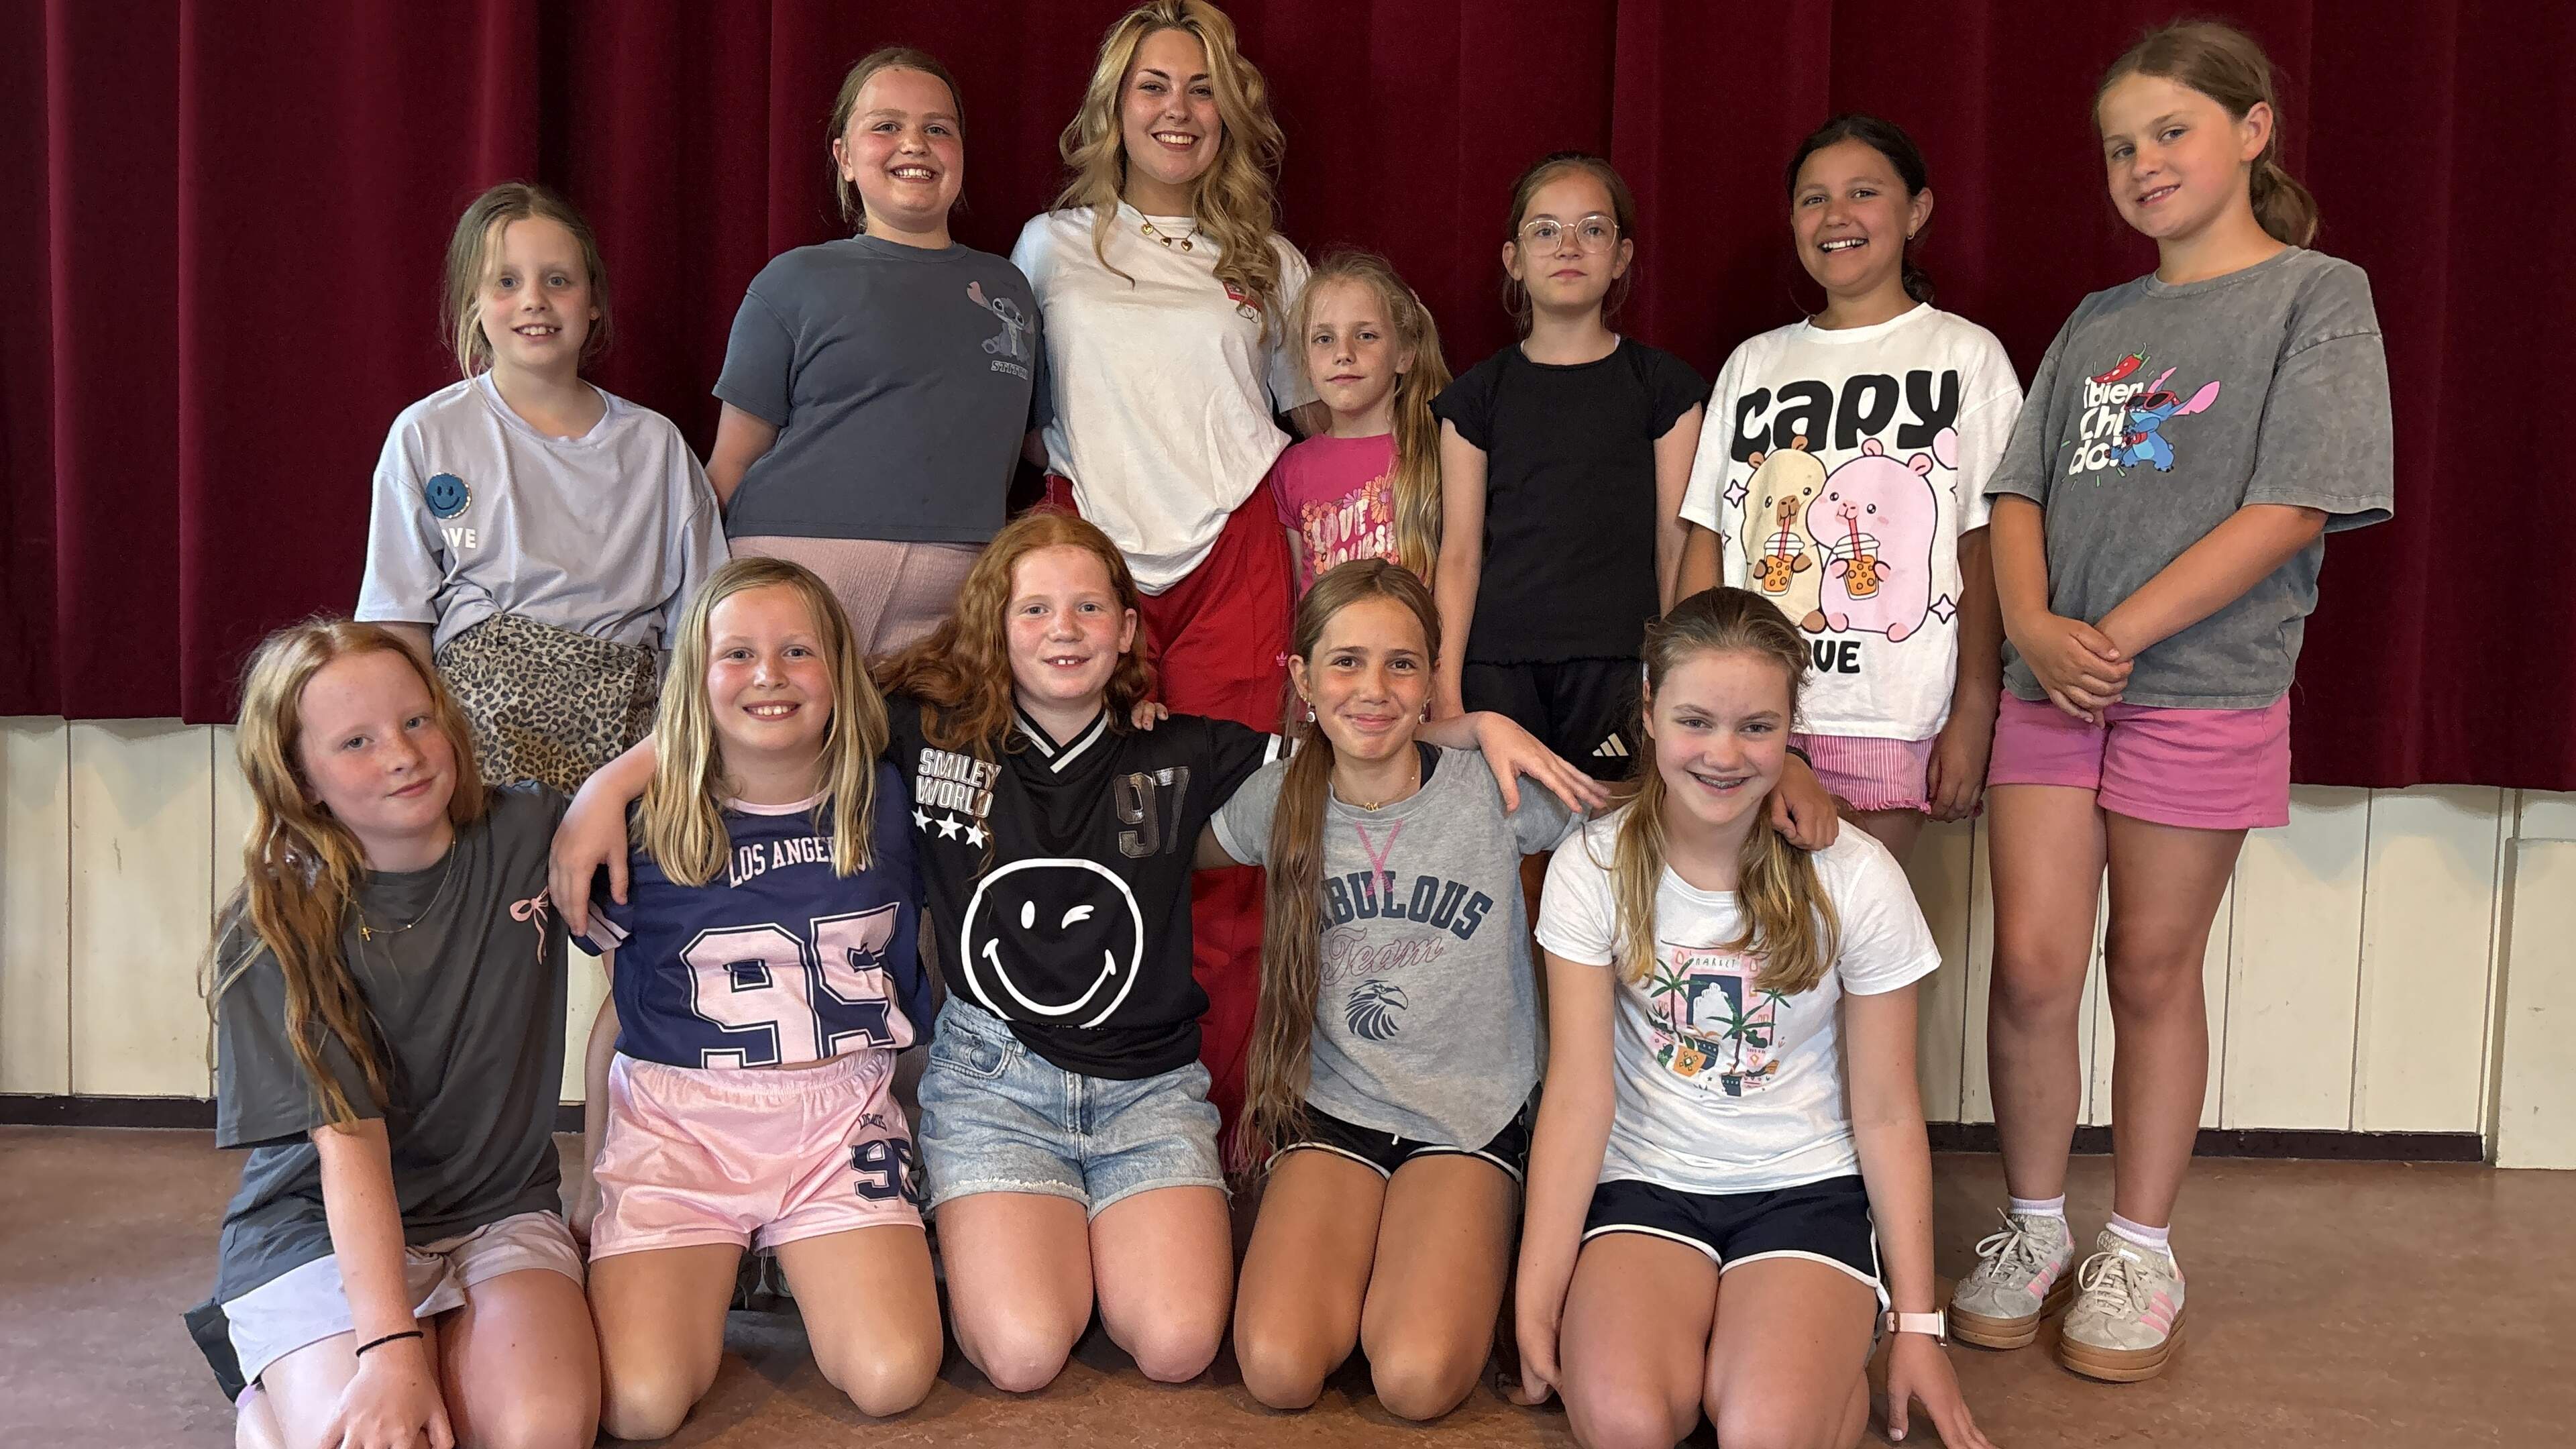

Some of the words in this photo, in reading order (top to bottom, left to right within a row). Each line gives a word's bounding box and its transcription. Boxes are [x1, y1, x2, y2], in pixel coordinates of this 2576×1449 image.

[441, 527, 476, 549] VE
[1311, 498, 1369, 553] LOVE
[1813, 639, 1861, 674] VE
[918, 748, 1002, 790] SMILEY
[916, 775, 994, 818] WORLD
[1113, 766, 1191, 858] 97
[727, 843, 765, 888] LOS
[1320, 871, 1494, 940] BULOUS
[1320, 926, 1444, 986] Team
[679, 902, 916, 1069] 95
